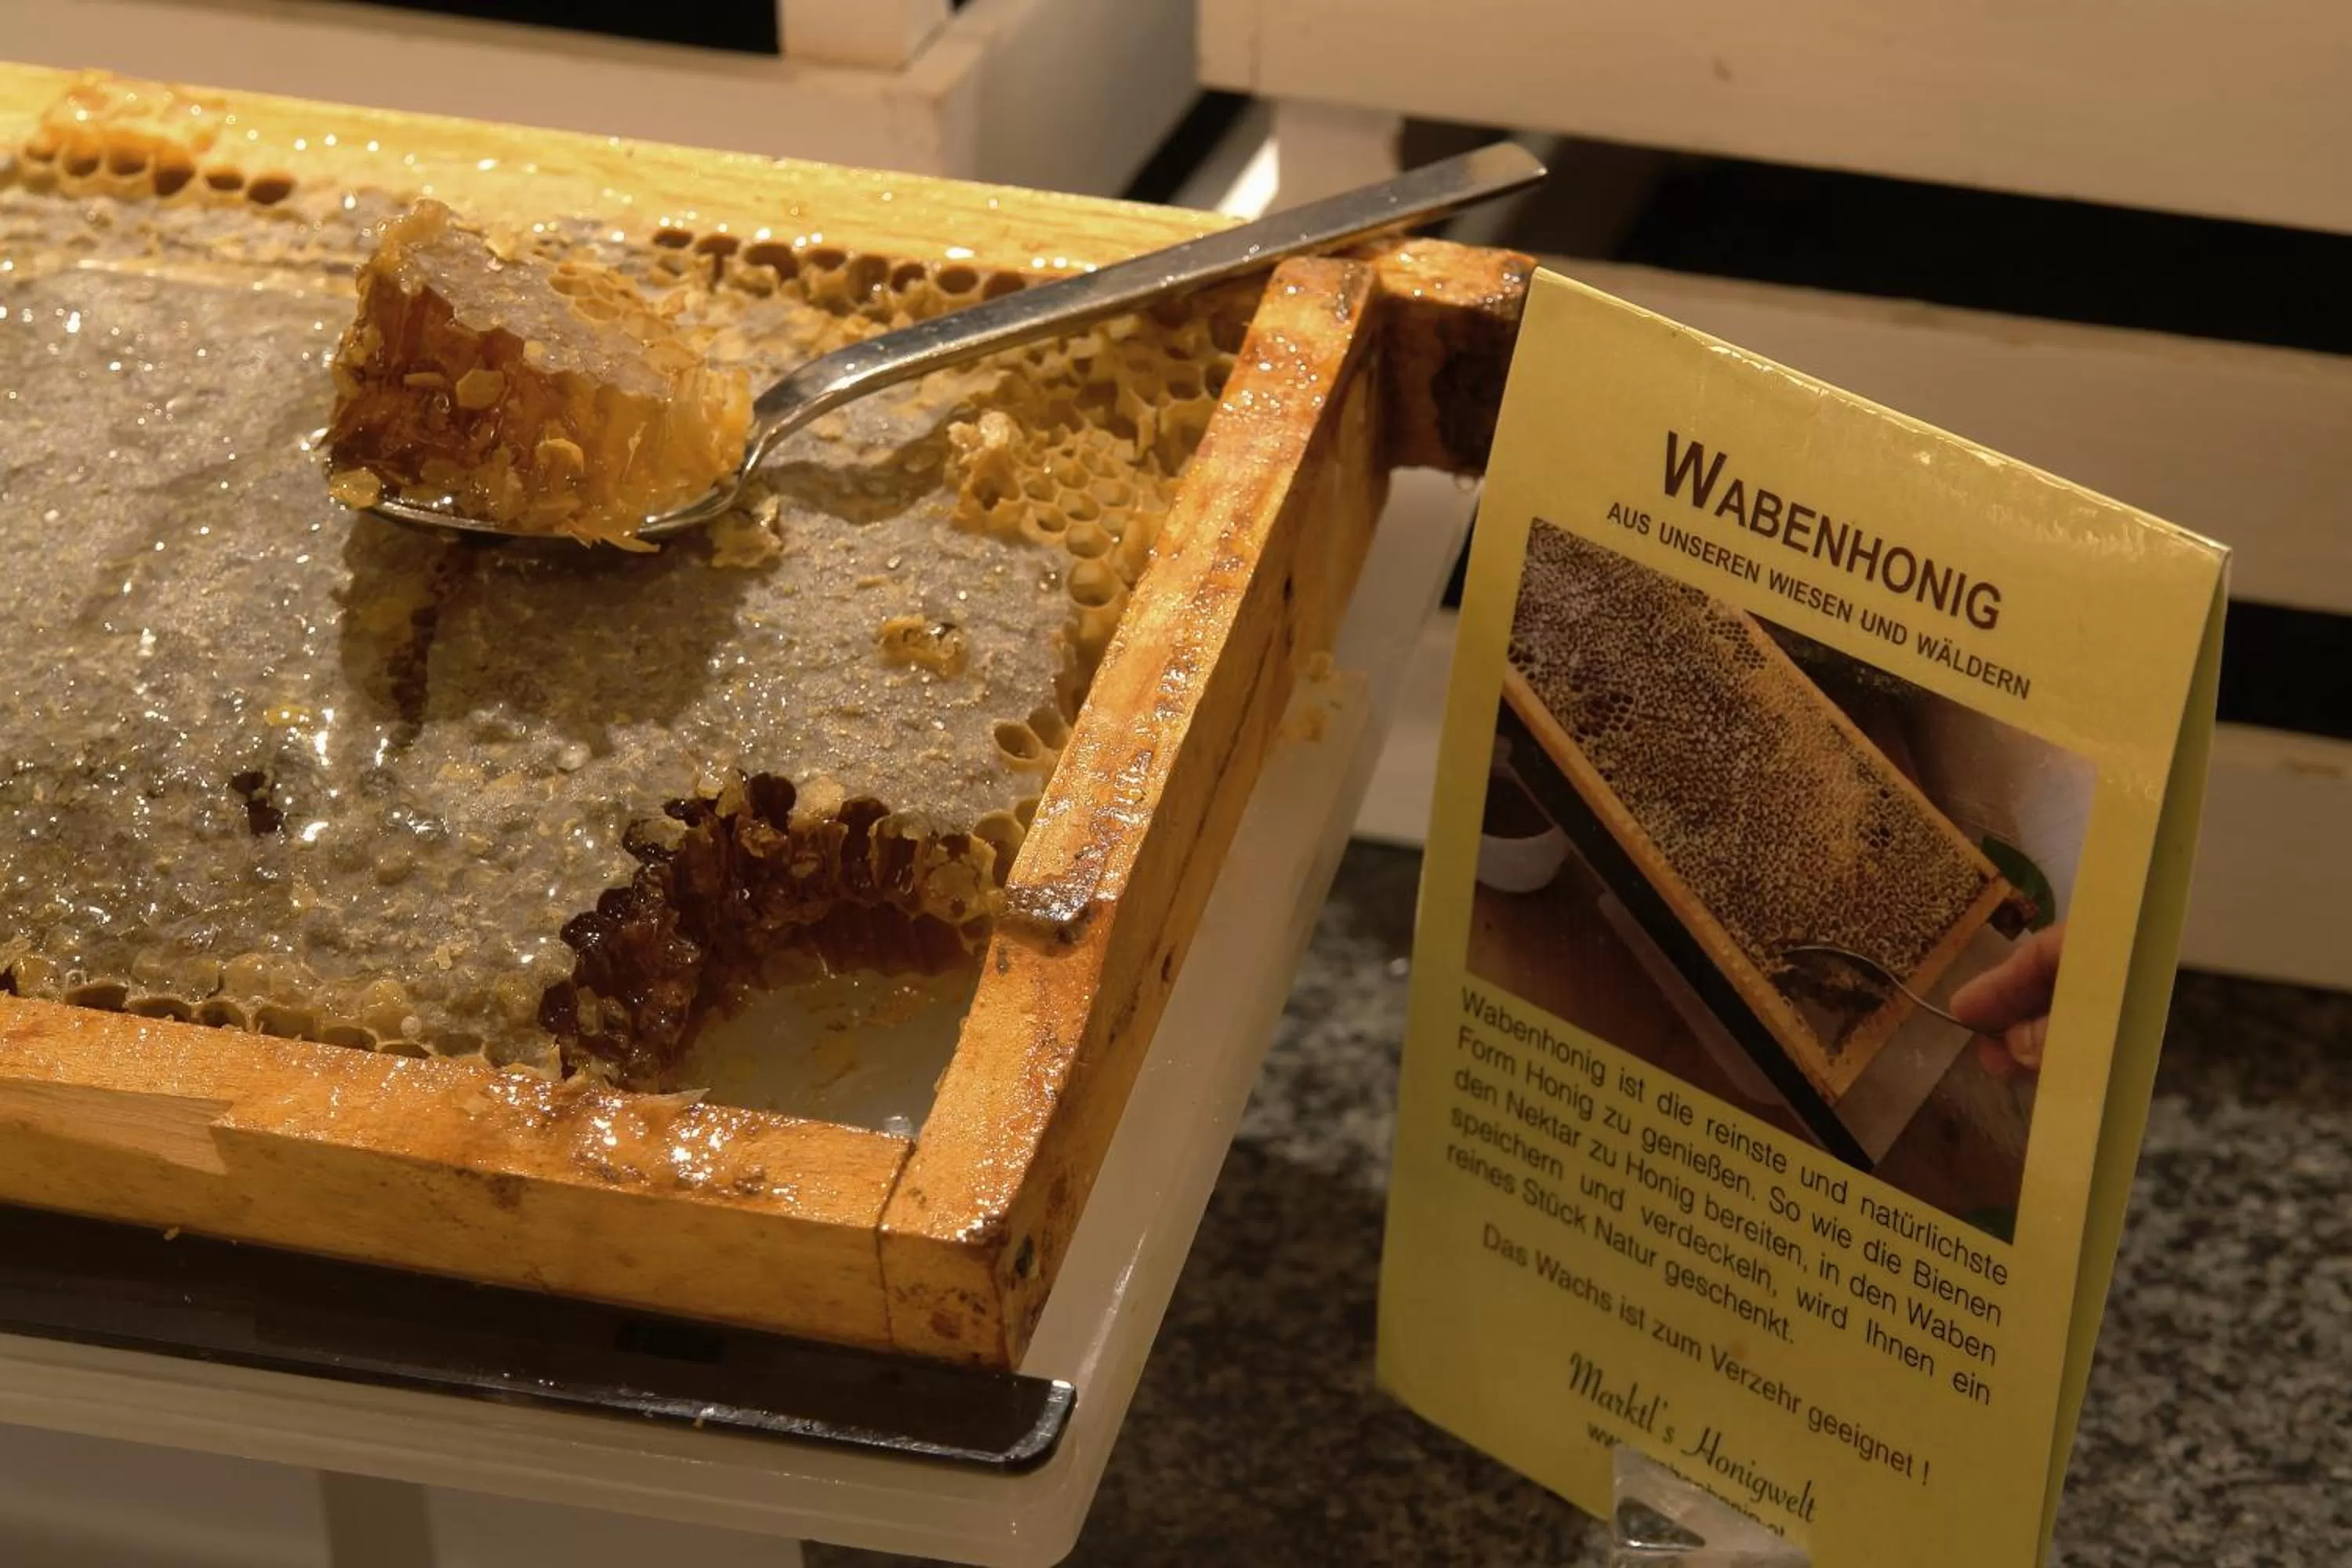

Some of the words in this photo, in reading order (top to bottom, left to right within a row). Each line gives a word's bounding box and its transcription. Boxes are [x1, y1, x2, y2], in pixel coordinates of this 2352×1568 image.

[1606, 500, 1651, 534] AUS
[1658, 521, 1761, 585] UNSEREN
[1768, 568, 1853, 623] WIESEN
[1860, 609, 1907, 646] UND
[1916, 636, 2031, 700] WÄLDERN
[1663, 430, 2002, 630] WABENHONIG
[1446, 1143, 1515, 1196] reines
[1522, 1177, 1588, 1234] Stück
[1594, 1215, 1657, 1268] Natur
[1664, 1259, 1795, 1344] geschenkt.
[1450, 1106, 1563, 1180] speichern
[1580, 1174, 1625, 1211] und
[1797, 1287, 1848, 1330] wird
[1866, 1318, 1934, 1377] Ihnen
[1953, 1370, 1991, 1406] ein
[1454, 1066, 1497, 1106] den
[1506, 1089, 1582, 1149] Nektar
[1589, 1139, 1617, 1167] zu
[1626, 1151, 1694, 1214] Honig
[1819, 1253, 1840, 1284] in
[1849, 1274, 1896, 1315] den
[1907, 1298, 1995, 1367] Waben
[1458, 1025, 1516, 1076] Form
[1526, 1062, 1594, 1121] Honig
[1602, 1105, 1631, 1135] zu
[1769, 1185, 1801, 1221] So
[1812, 1213, 1853, 1249] wie
[1864, 1240, 1902, 1275] die
[1914, 1258, 2002, 1327] Bienen
[1461, 985, 1606, 1087] Wabenhonig
[1618, 1067, 1644, 1103] ist
[1657, 1091, 1693, 1127] die
[1706, 1116, 1787, 1174] reinste
[1801, 1166, 1848, 1204] und
[1860, 1196, 2008, 1285] natürlichste
[1483, 1223, 1528, 1267] Das
[1534, 1248, 1613, 1312] Wachs
[1619, 1294, 1645, 1330] ist
[1652, 1319, 1702, 1362] zum
[1710, 1343, 1802, 1414] Verzehr
[1807, 1405, 1914, 1478] geeignet
[1680, 1427, 1817, 1523] Honigwelt
